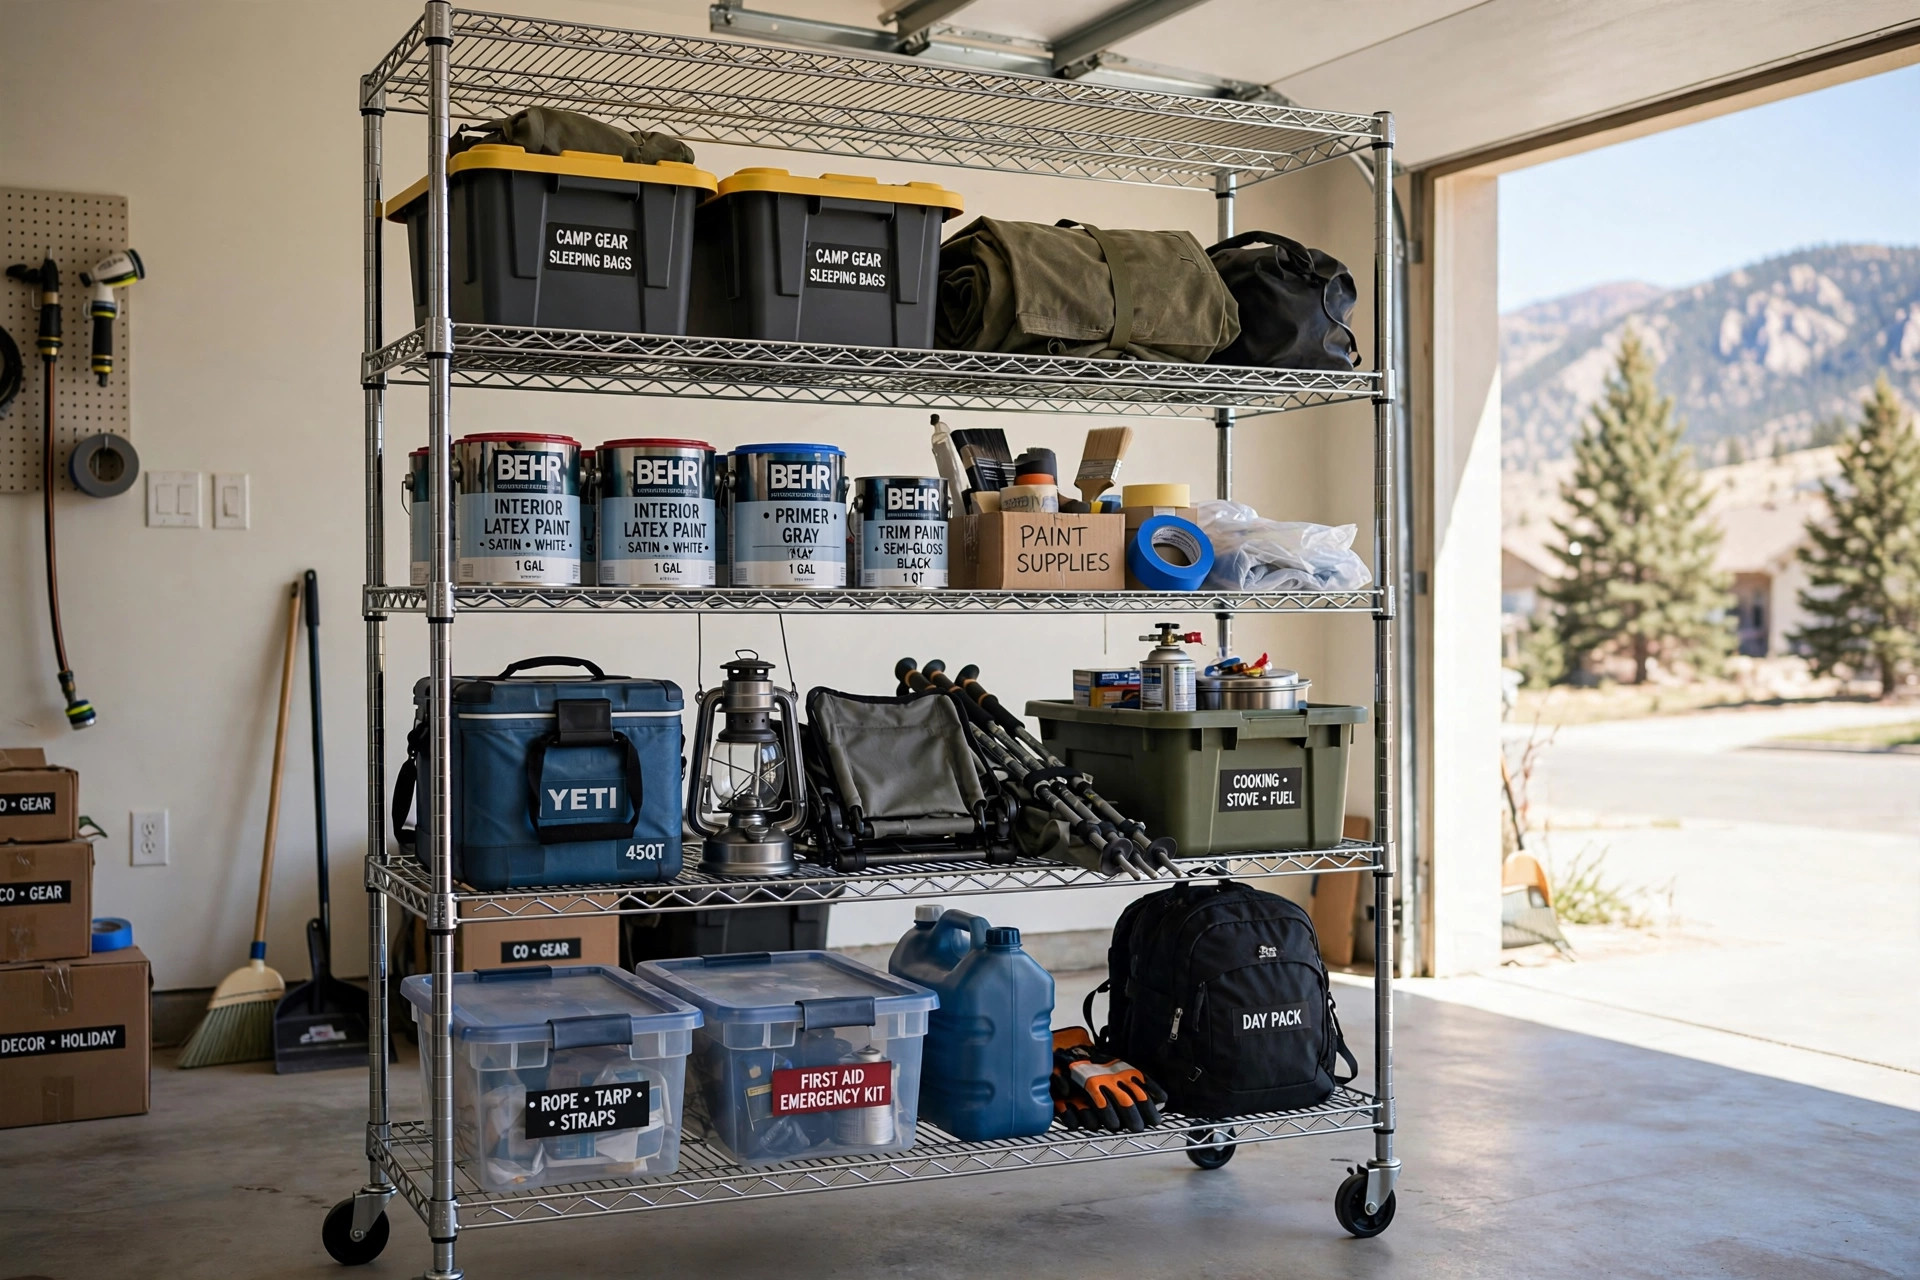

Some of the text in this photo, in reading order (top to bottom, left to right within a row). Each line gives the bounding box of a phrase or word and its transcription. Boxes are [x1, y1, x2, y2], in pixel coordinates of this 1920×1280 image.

[556, 229, 629, 250] CAMP GEAR
[549, 250, 632, 270] SLEEPING BAGS
[815, 248, 882, 268] CAMP GEAR
[810, 268, 886, 287] SLEEPING BAGS
[497, 454, 561, 482] BEHR
[636, 459, 698, 487] BEHR
[770, 464, 830, 491] BEHR
[495, 498, 562, 515] INTERIOR
[887, 487, 939, 511] BEHR
[634, 503, 699, 519] INTERIOR
[775, 508, 829, 524] PRIMER
[485, 518, 530, 534] LATEX
[535, 519, 570, 535] PAINT
[624, 522, 707, 538] LATEX PAINT
[878, 525, 945, 540] TRIM PAINT
[783, 527, 819, 544] GRAY
[1020, 525, 1088, 548] PAINT
[488, 538, 566, 551] SATIN WHITE
[628, 541, 703, 553] SATIN WHITE
[884, 542, 943, 555] SEMI-GLOSS
[515, 560, 544, 571] 1 GAL
[654, 562, 682, 573] 1 GAL
[789, 563, 815, 574] 1 GAL
[897, 557, 931, 569] BLACK
[1017, 552, 1110, 573] SUPPLIES
[903, 572, 924, 585] 1 QT
[20, 797, 51, 811] GEAR
[547, 787, 617, 811] YETI
[1227, 790, 1295, 807] STOVE FUEL
[625, 843, 665, 861] 45QT
[29, 885, 62, 900] GEAR
[512, 942, 569, 959] CO GEAR
[1242, 1008, 1302, 1030] DAY PACK
[1, 1029, 117, 1053] DECOR HOLIDAY
[801, 1068, 865, 1090] FIRST AID
[541, 1087, 632, 1112] ROPE TARP
[780, 1085, 885, 1111] EMERGENCY KIT
[560, 1109, 616, 1131] STRAPS
